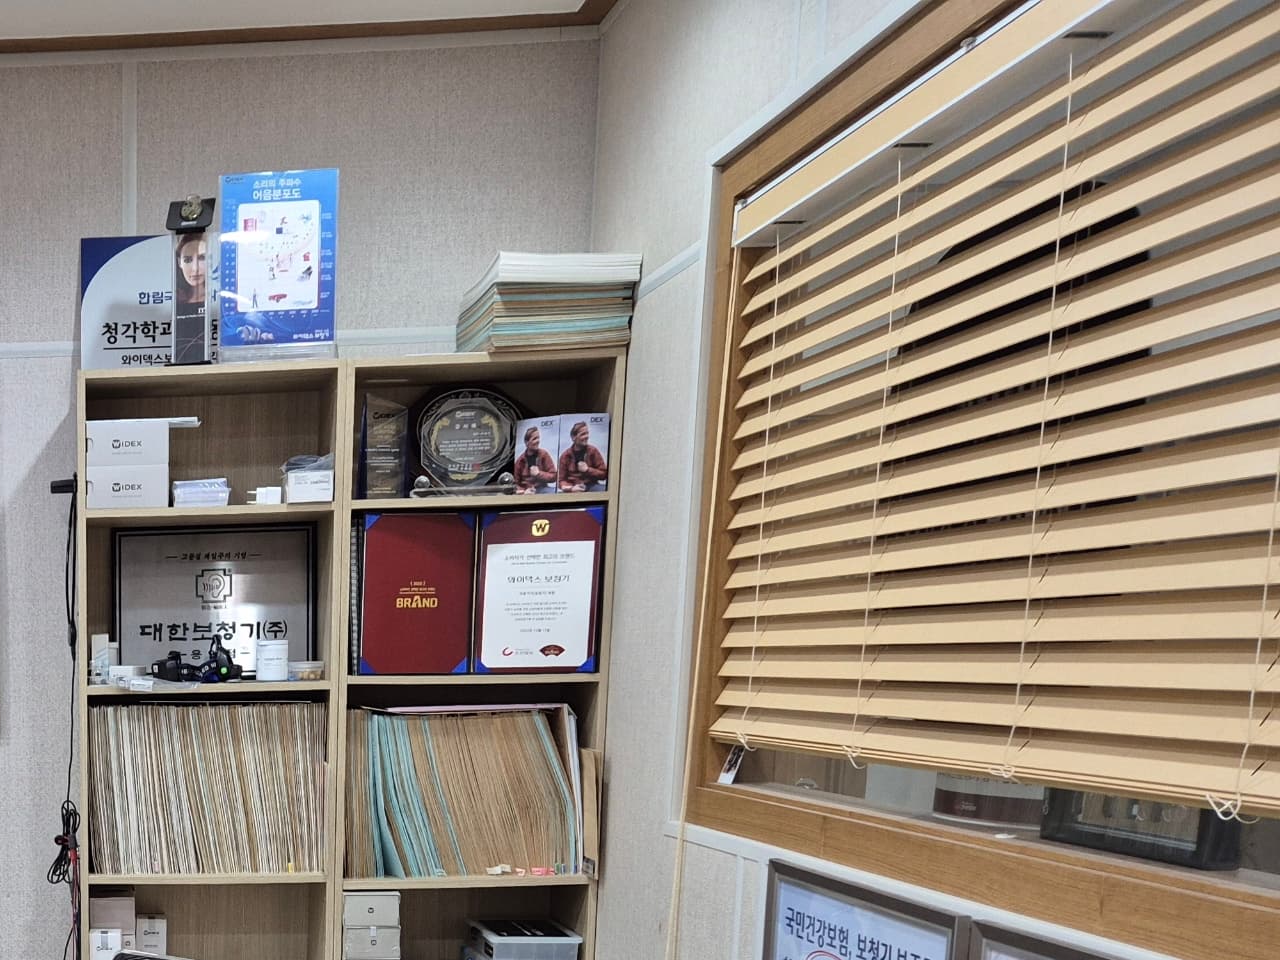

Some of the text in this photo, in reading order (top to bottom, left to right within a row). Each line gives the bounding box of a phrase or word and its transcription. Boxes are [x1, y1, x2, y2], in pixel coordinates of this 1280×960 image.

[252, 188, 302, 200] 어음분포도
[111, 439, 143, 449] WIDEX
[111, 483, 143, 492] WIDEX
[396, 595, 439, 608] BRAND
[139, 619, 288, 642] 대한보청기(주)
[785, 906, 852, 960] 국민건강보험,
